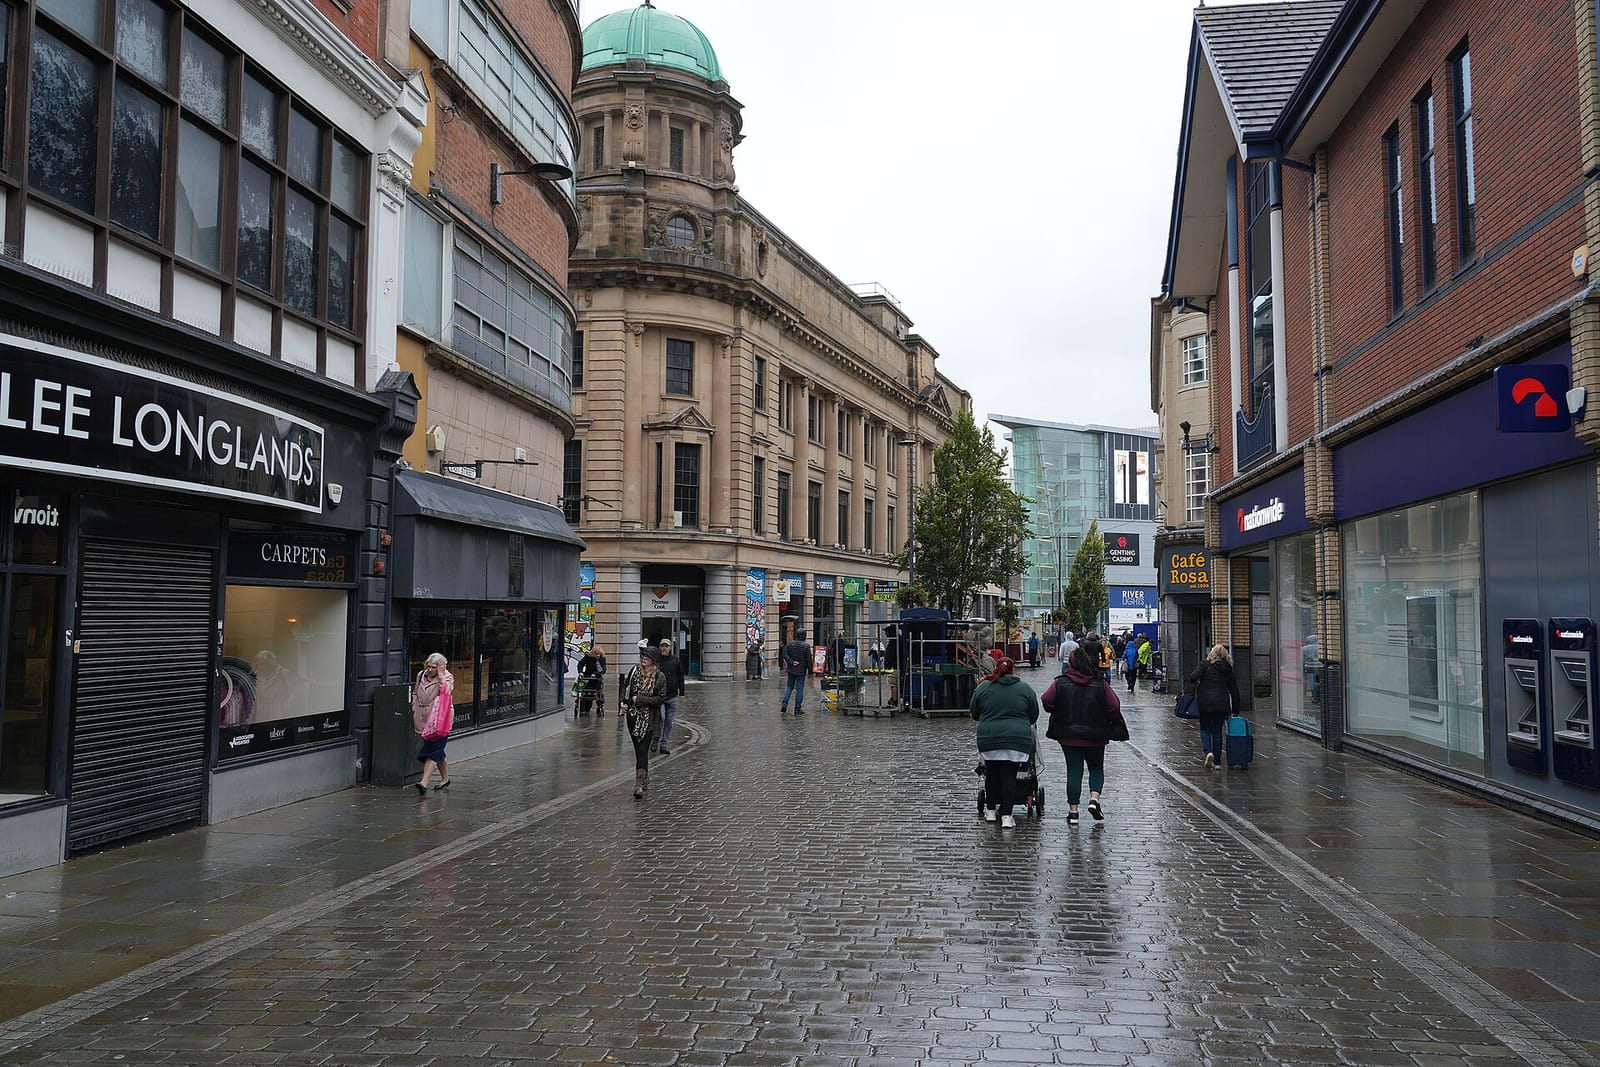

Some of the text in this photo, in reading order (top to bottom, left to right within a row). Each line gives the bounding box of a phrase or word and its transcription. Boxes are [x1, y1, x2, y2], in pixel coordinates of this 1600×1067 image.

[0, 371, 313, 486] LEE LONGLANDS
[1243, 497, 1285, 532] nationwide
[261, 542, 326, 566] CARPETS
[1171, 551, 1206, 568] Café
[1170, 569, 1209, 584] Rosa
[1122, 590, 1144, 598] RIVER
